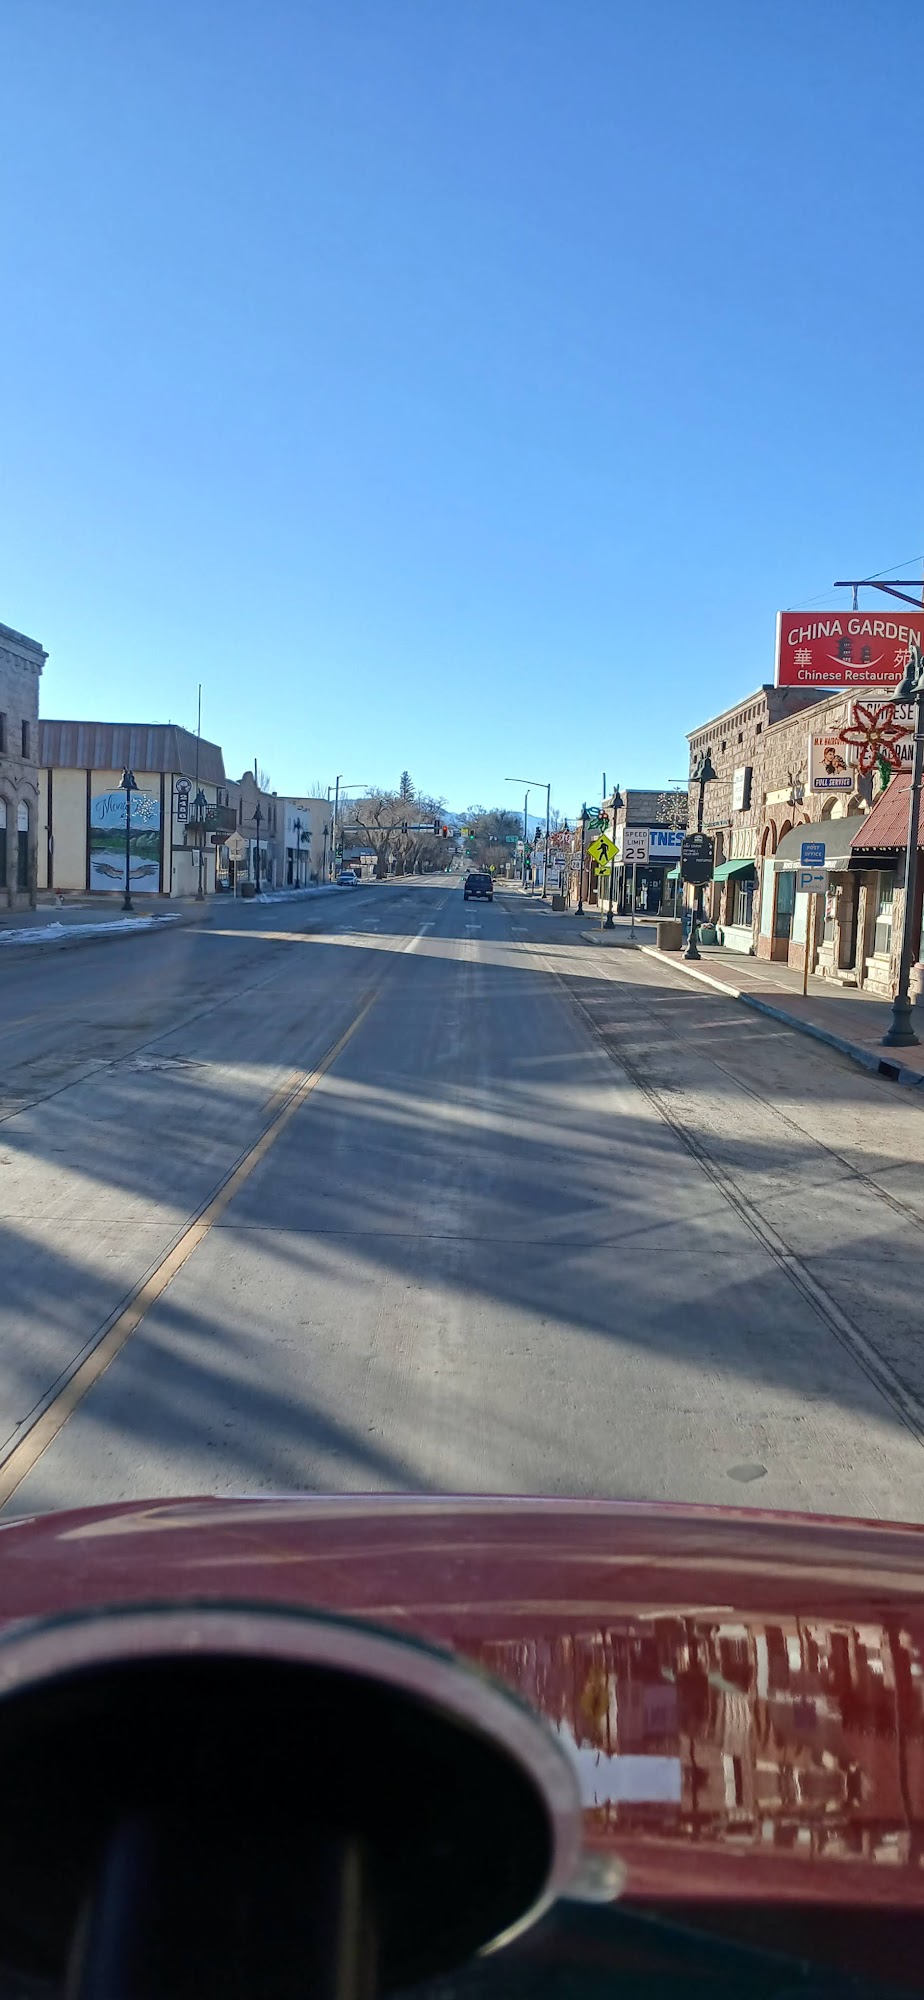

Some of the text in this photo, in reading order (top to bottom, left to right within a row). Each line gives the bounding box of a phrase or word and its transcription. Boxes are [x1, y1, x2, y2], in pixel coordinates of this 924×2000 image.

[788, 619, 921, 648] CHINA GARDEN
[793, 648, 813, 667] 華
[797, 670, 905, 681] Chinese Restauran
[815, 778, 850, 787] FULL SERVICE
[625, 848, 646, 860] 25
[801, 873, 813, 889] P
